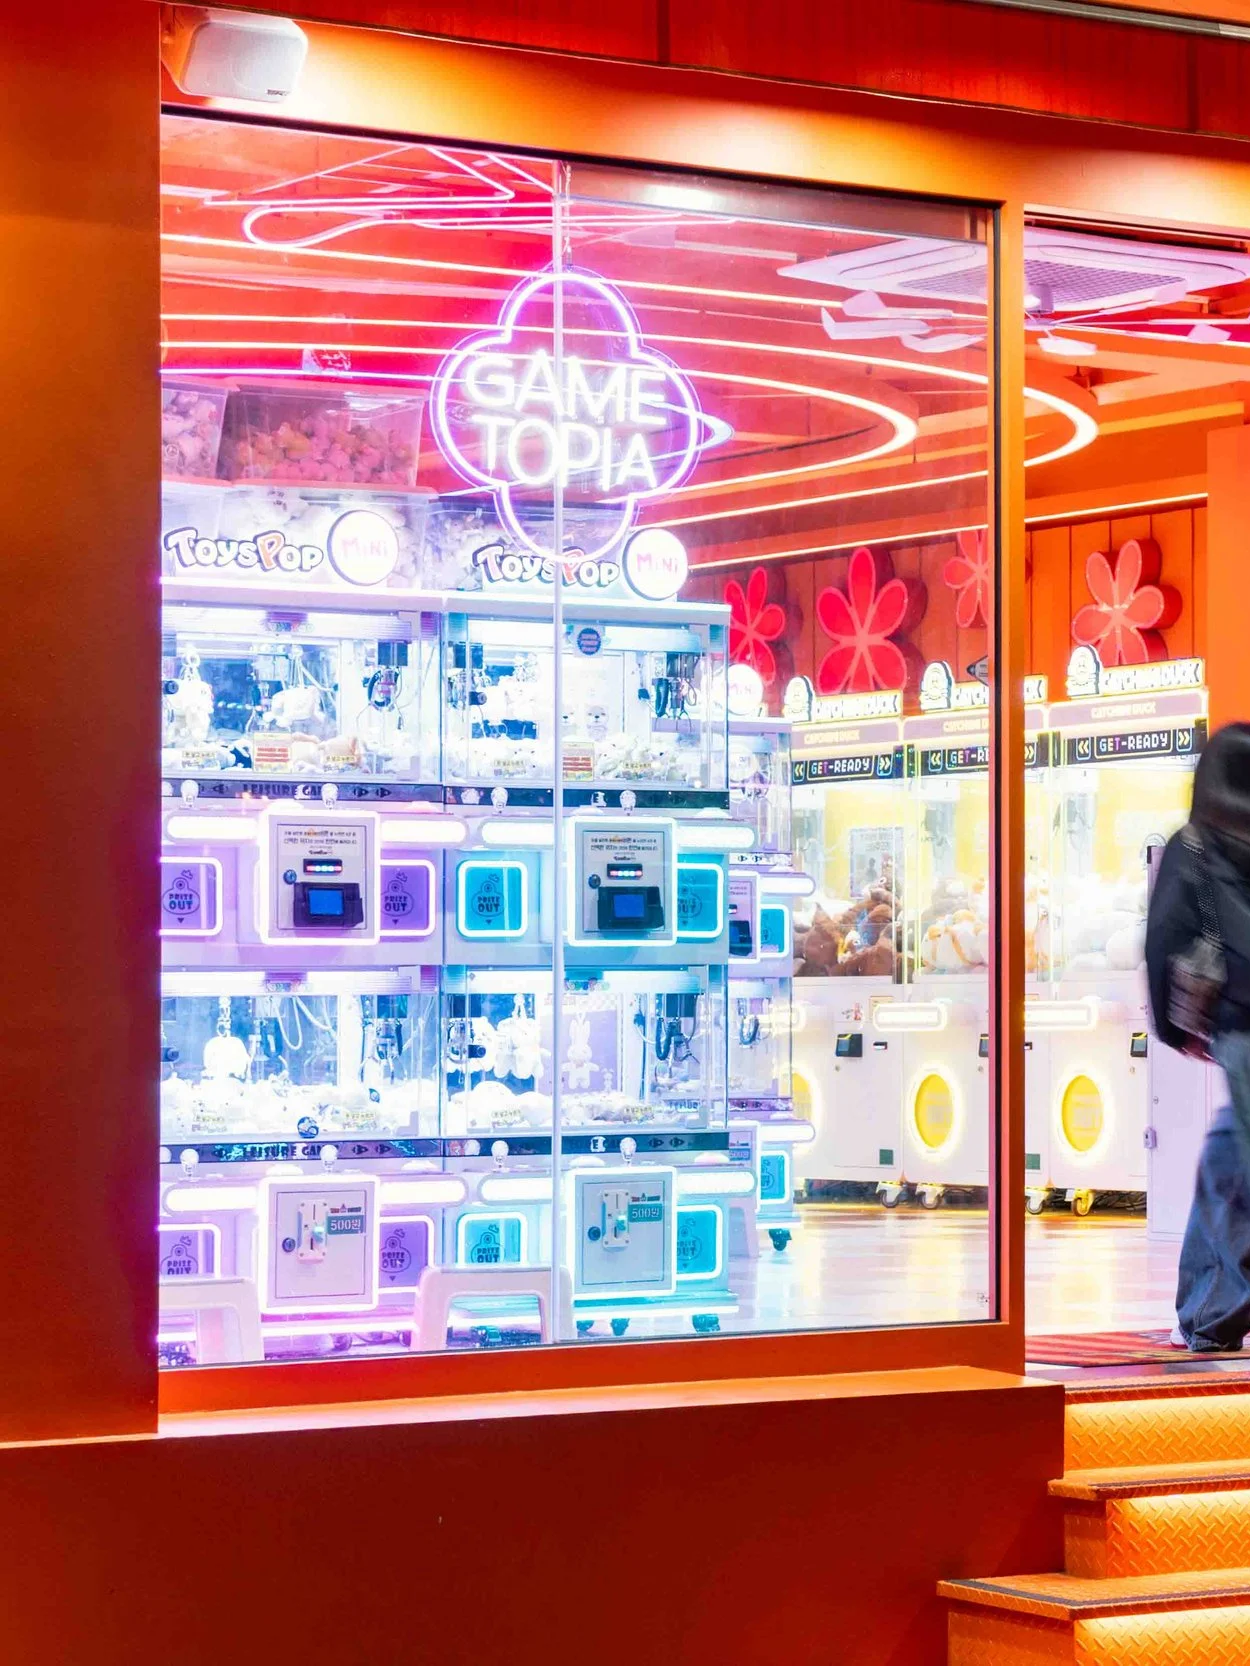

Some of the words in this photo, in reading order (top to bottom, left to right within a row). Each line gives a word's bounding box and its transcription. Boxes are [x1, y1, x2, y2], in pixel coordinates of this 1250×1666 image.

[465, 349, 667, 425] GAME
[471, 415, 658, 492] TOPIA
[1099, 732, 1168, 752] GET-READY
[811, 757, 870, 775] GET-READY
[169, 900, 193, 910] OUT
[384, 902, 407, 911] OUT
[478, 903, 500, 912] OUT
[632, 1207, 660, 1219] 500원
[331, 1219, 361, 1231] 500원
[382, 1259, 405, 1269] OUT
[477, 1254, 499, 1263] OUT
